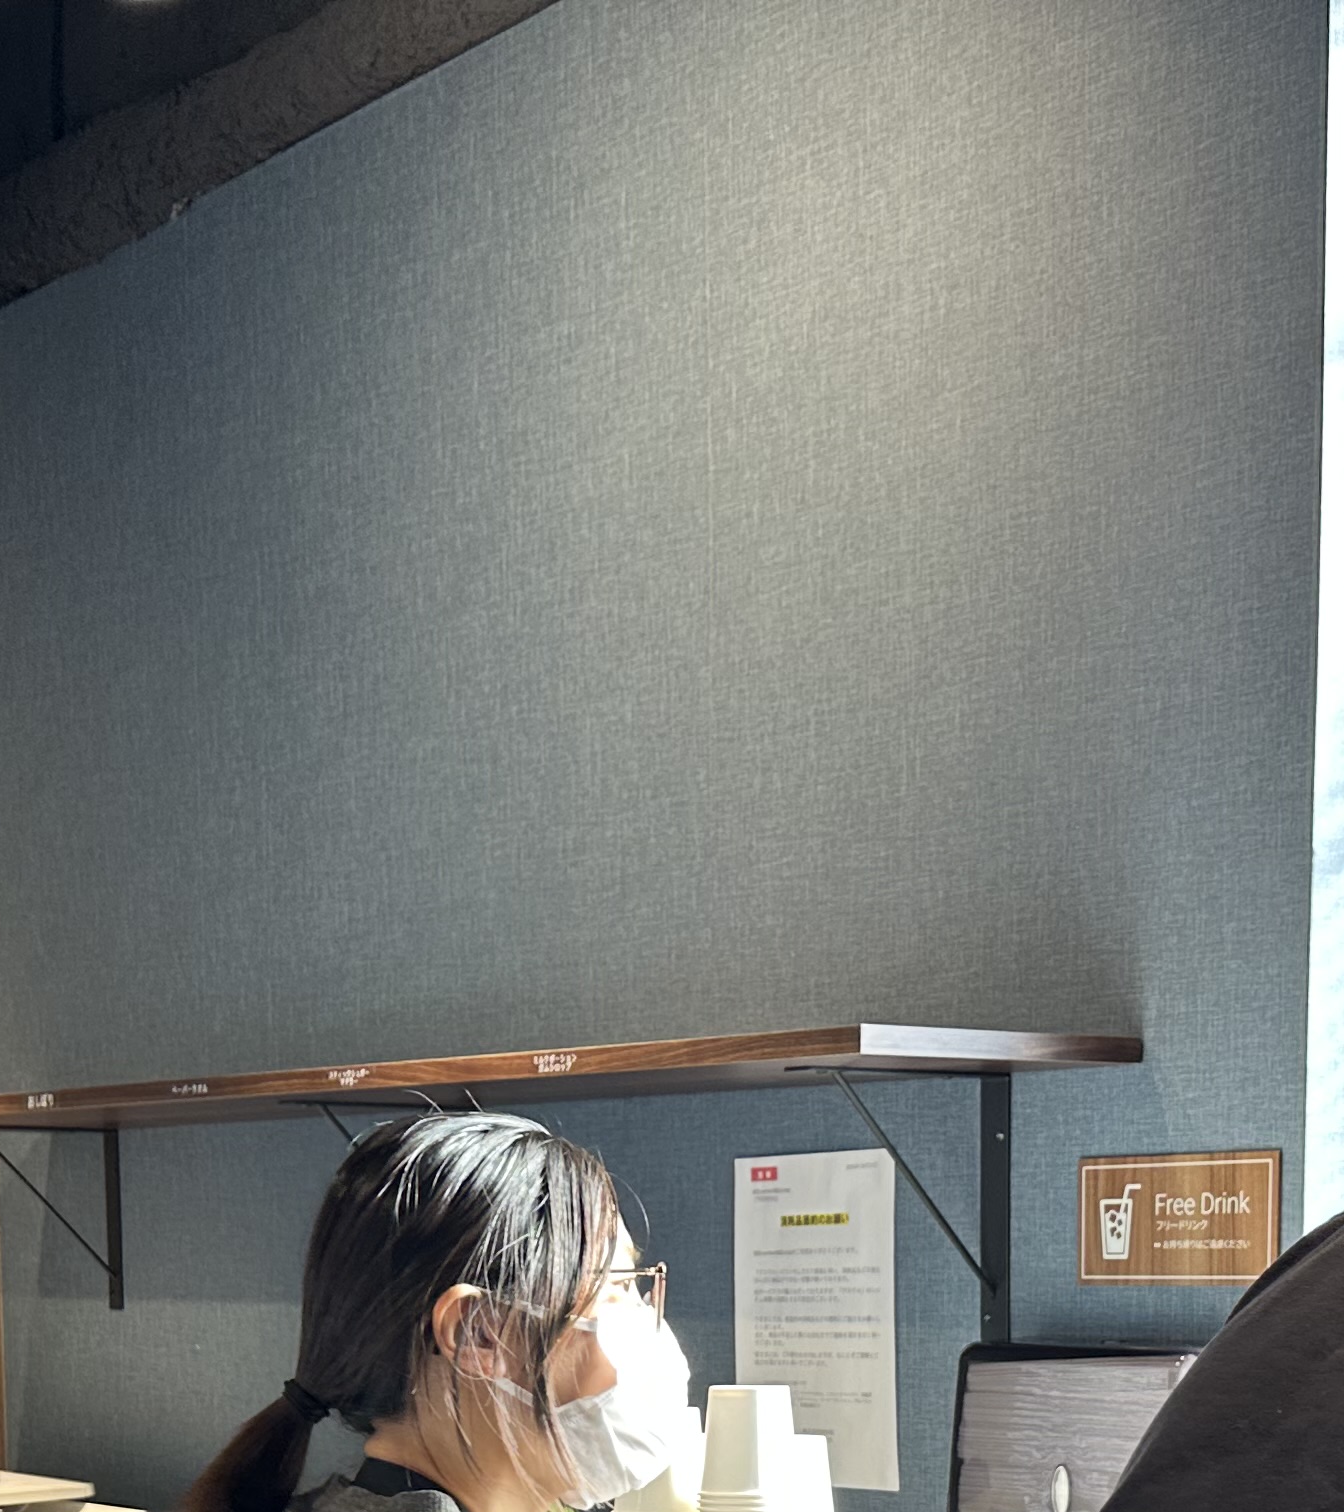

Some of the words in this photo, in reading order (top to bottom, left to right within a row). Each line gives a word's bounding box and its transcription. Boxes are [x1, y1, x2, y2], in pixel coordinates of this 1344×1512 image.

[1154, 1193, 1196, 1217] Free
[1200, 1190, 1251, 1216] Drink
[1156, 1219, 1209, 1231] フリードリンク
